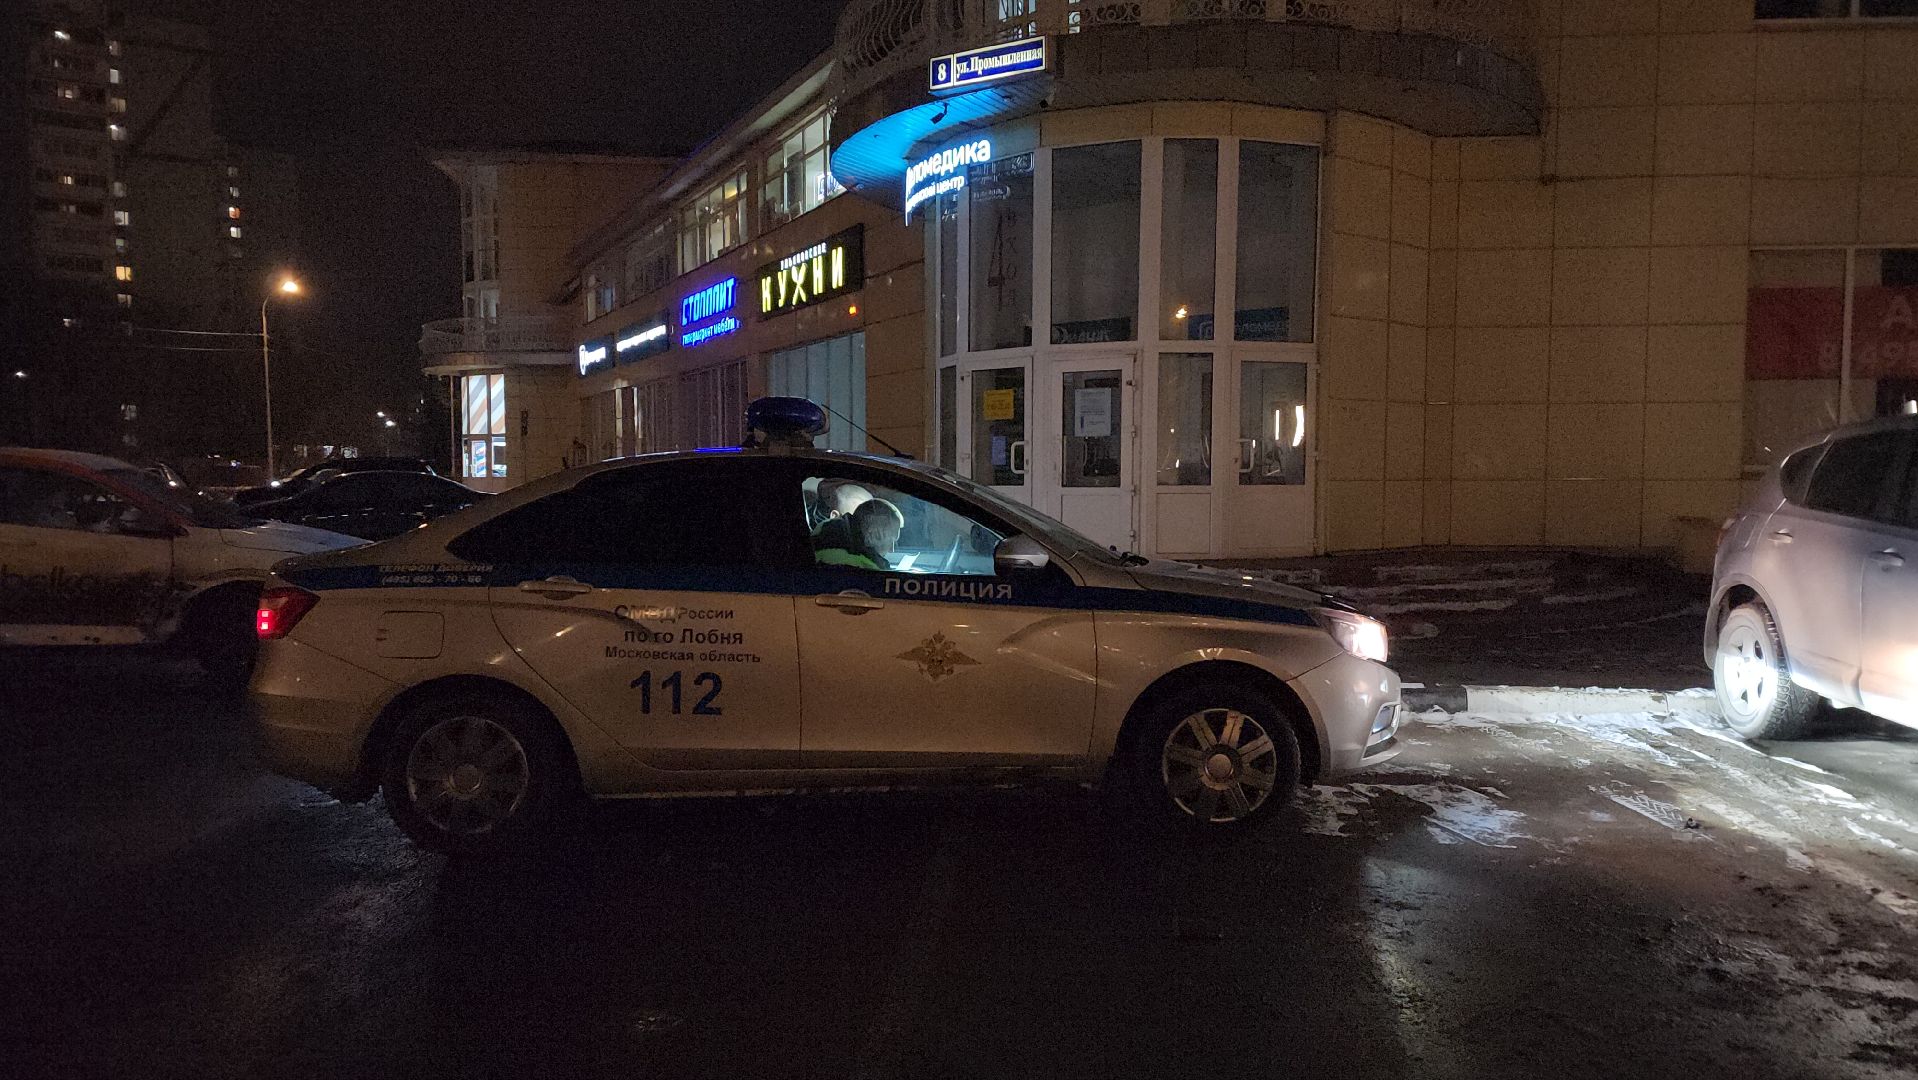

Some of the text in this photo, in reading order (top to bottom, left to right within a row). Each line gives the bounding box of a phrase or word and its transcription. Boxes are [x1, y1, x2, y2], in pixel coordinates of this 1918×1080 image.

[937, 63, 947, 82] 8
[761, 246, 843, 313] КУХНИ
[884, 577, 1013, 600] ПОЛИЦИЯ
[678, 607, 734, 620] России
[624, 630, 648, 643] по
[680, 628, 744, 645] Лобня
[605, 645, 761, 663] Московская область
[630, 670, 722, 715] 112
